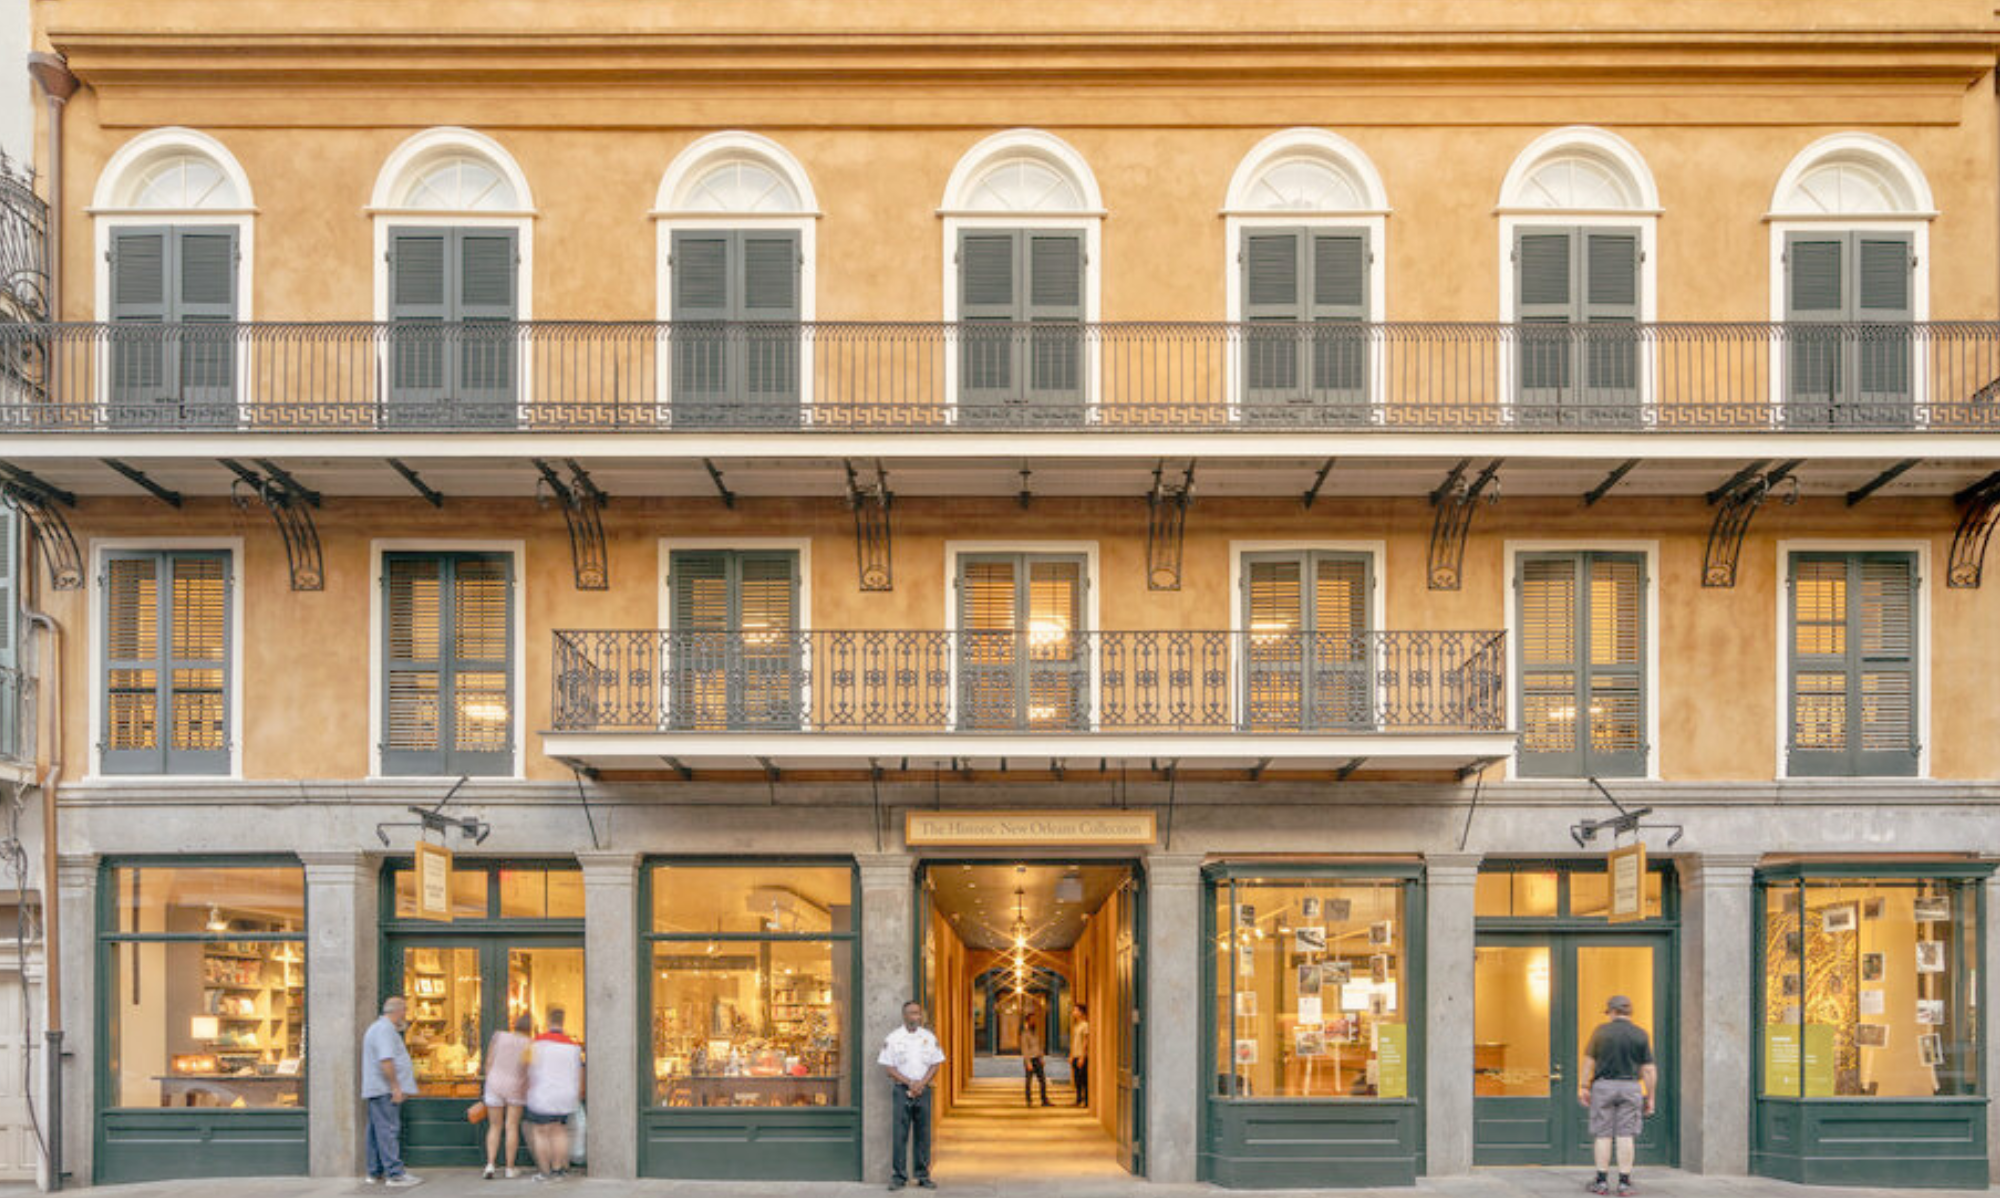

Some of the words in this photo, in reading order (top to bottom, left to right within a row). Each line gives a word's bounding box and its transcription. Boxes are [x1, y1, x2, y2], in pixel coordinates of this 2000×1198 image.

[922, 821, 944, 835] The
[950, 821, 995, 835] Historic
[1001, 821, 1027, 835] New
[1030, 821, 1075, 835] Orleans
[1079, 820, 1141, 835] Collection
